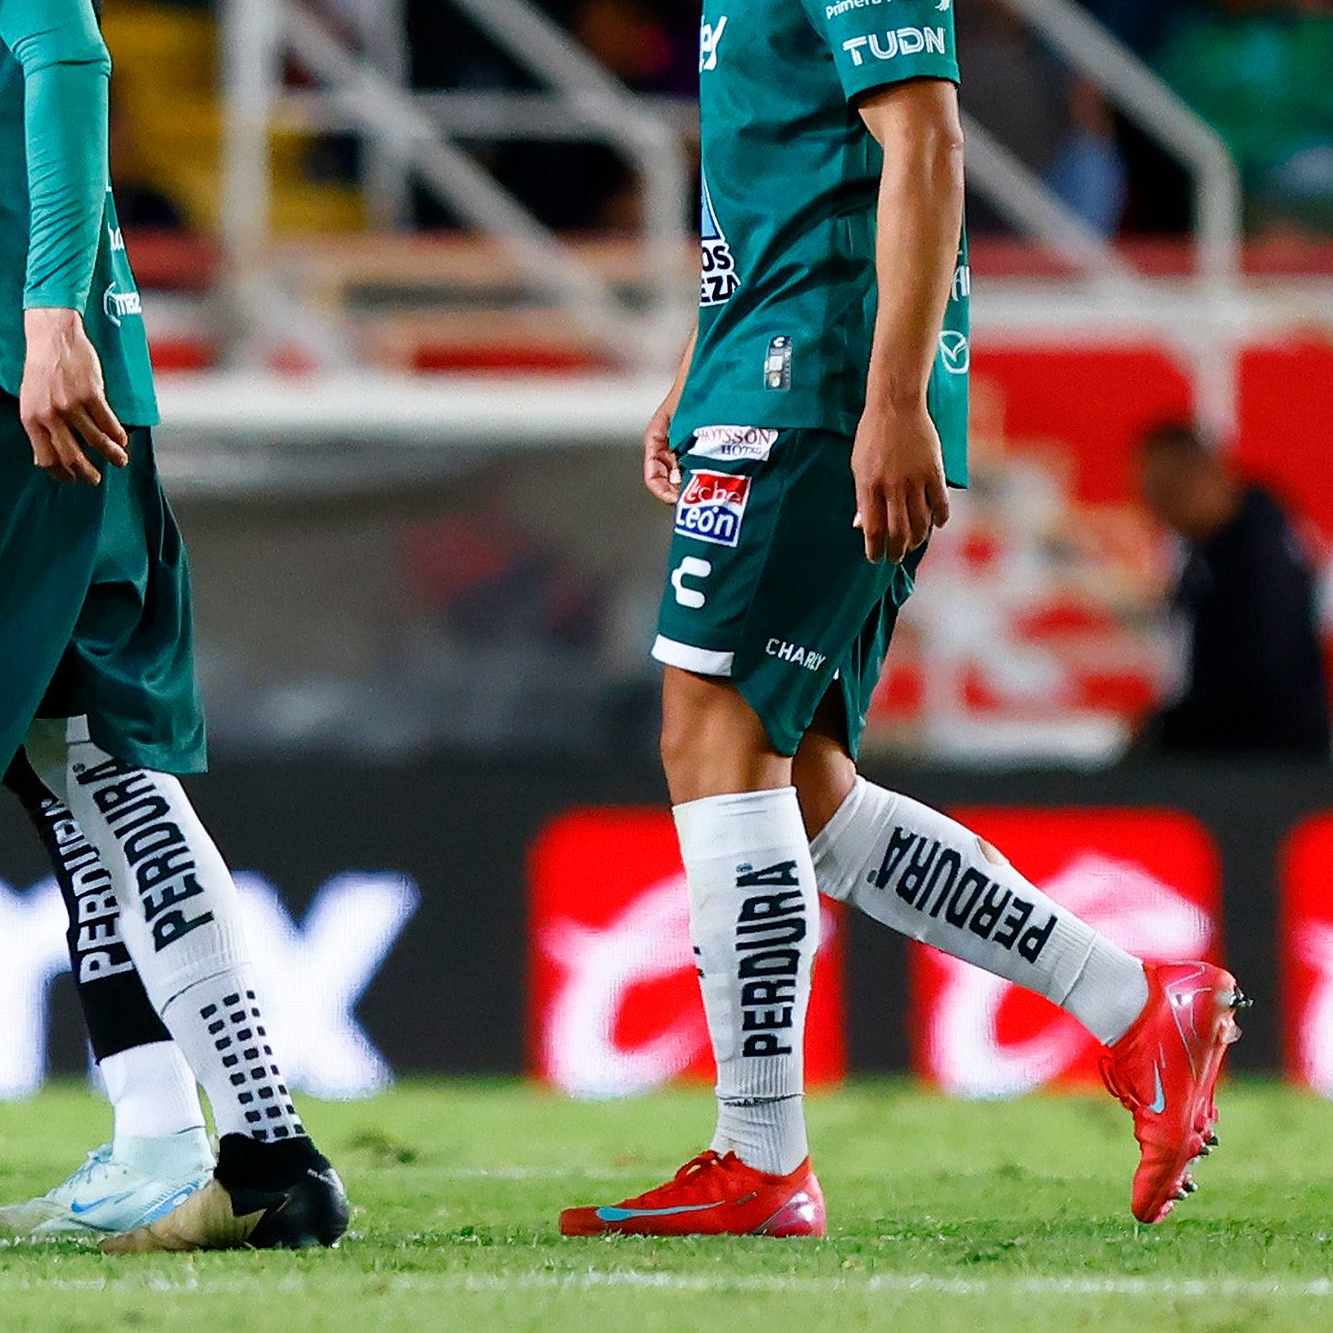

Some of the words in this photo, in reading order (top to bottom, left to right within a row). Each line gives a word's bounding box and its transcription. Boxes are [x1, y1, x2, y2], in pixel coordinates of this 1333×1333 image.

[842, 27, 945, 66] TUDN
[676, 507, 734, 537] León
[765, 638, 826, 672] CHARLY
[868, 825, 1058, 963] PERDURA
[736, 861, 808, 1059] PERDURA
